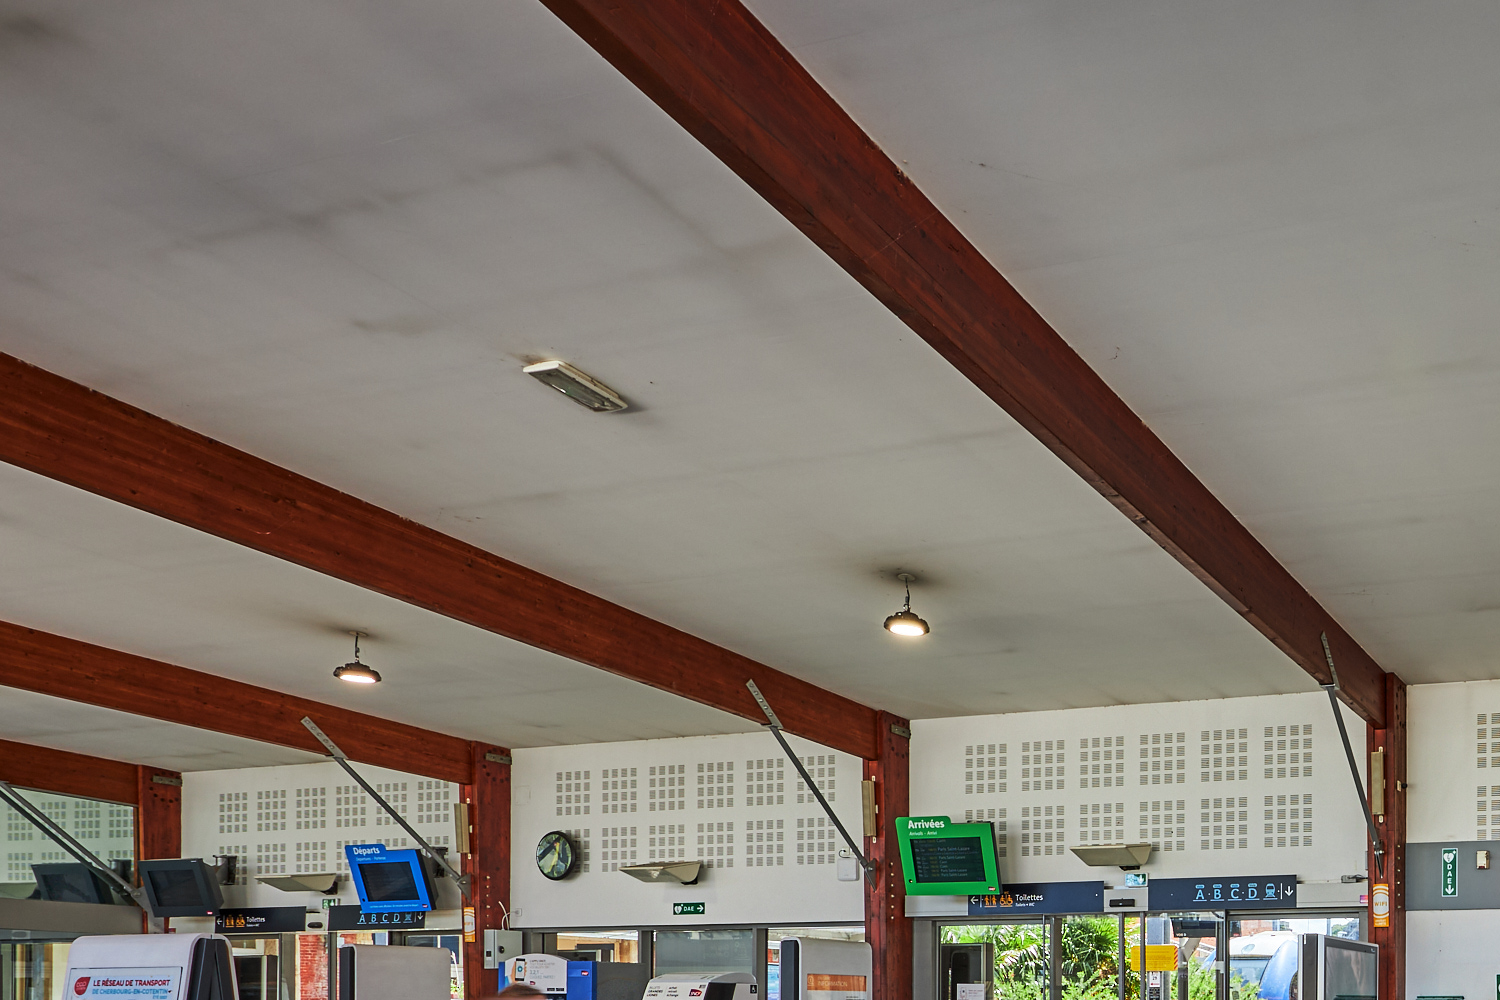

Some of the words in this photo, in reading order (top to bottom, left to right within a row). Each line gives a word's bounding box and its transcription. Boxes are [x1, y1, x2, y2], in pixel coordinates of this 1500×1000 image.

[908, 819, 945, 829] Arrivées
[353, 847, 380, 856] Départs
[1195, 890, 1205, 900] A
[1214, 889, 1222, 899] B
[1230, 888, 1239, 899] C
[1248, 888, 1257, 898] D
[359, 914, 366, 922] A
[371, 914, 377, 922] B
[382, 914, 388, 922] C
[394, 913, 400, 921] D
[101, 978, 125, 987] RÉSEAU
